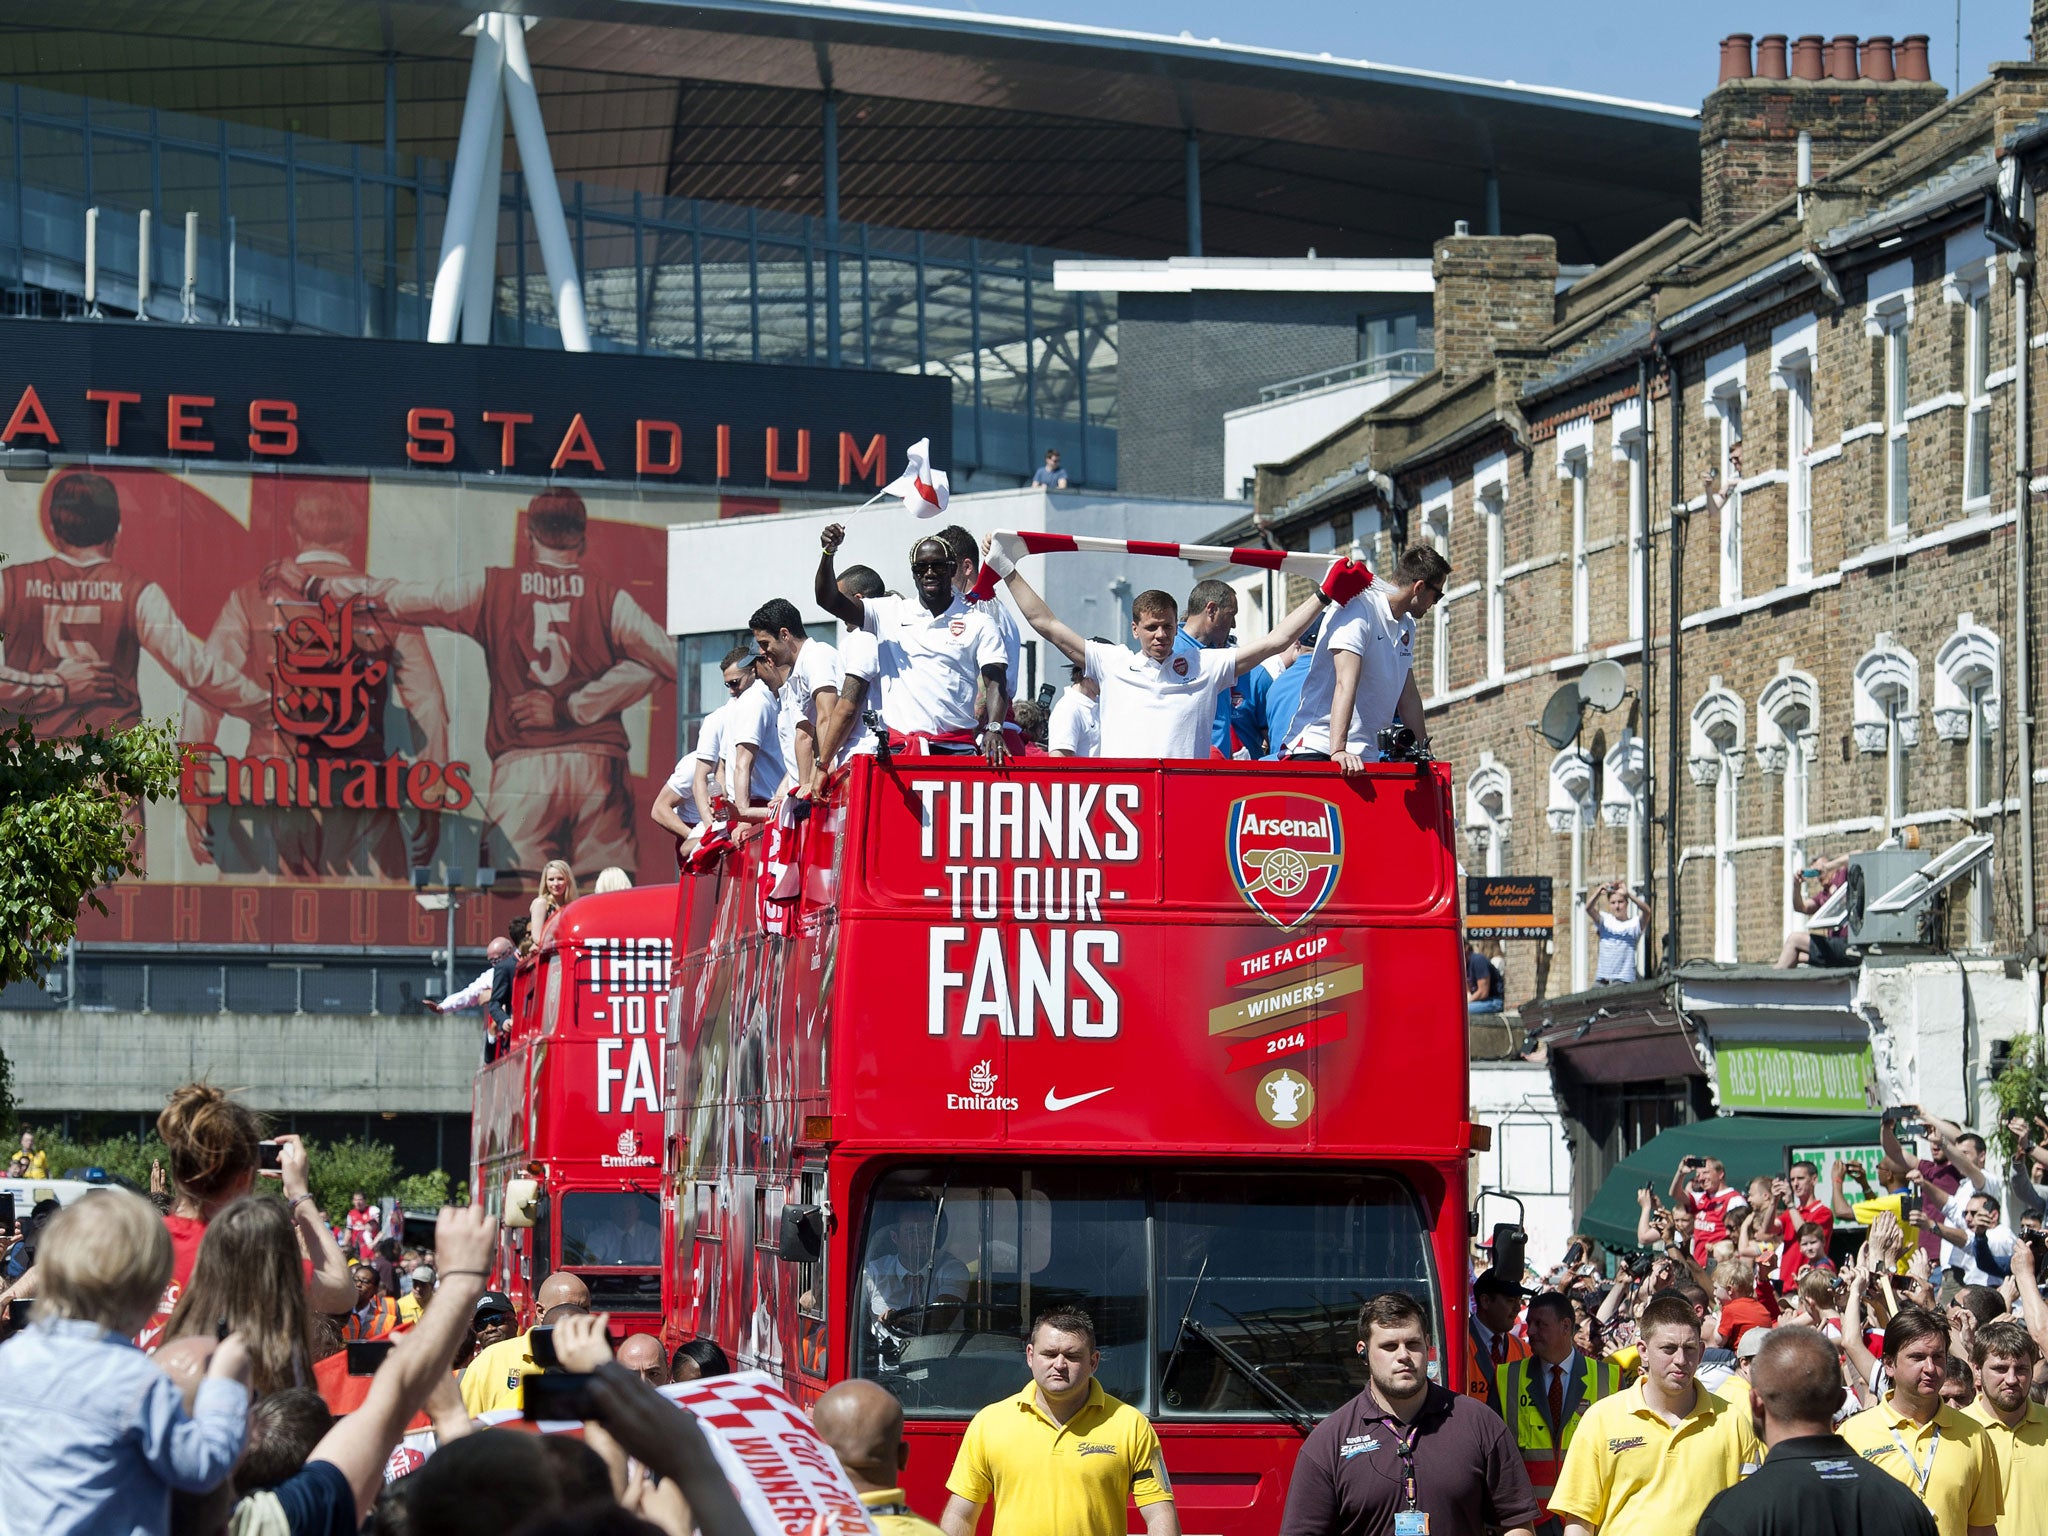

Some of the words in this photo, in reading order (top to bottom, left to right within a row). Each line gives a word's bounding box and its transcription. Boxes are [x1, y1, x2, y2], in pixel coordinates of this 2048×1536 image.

[406, 407, 888, 488] STADIUM
[25, 579, 124, 603] McLINTOCK
[520, 571, 584, 599] BOULD
[529, 600, 571, 687] 5
[177, 742, 474, 812] Emirates
[911, 780, 1140, 861] THANKS
[1241, 813, 1329, 838] Arsenal
[113, 885, 494, 945] THROUGH
[1470, 927, 1493, 937] 020
[1523, 927, 1548, 937] 9696
[1241, 955, 1271, 977] THE
[1274, 947, 1294, 969] FA
[1296, 937, 1328, 959] CUP
[927, 925, 1120, 1038] FANS
[1247, 981, 1326, 1019] WINNERS
[1266, 1032, 1306, 1054] 2014
[946, 1093, 1020, 1111] Emirates
[601, 1154, 656, 1168] Emirates
[1470, 1381, 1489, 1394] 82
[811, 1480, 872, 1536] FINA
